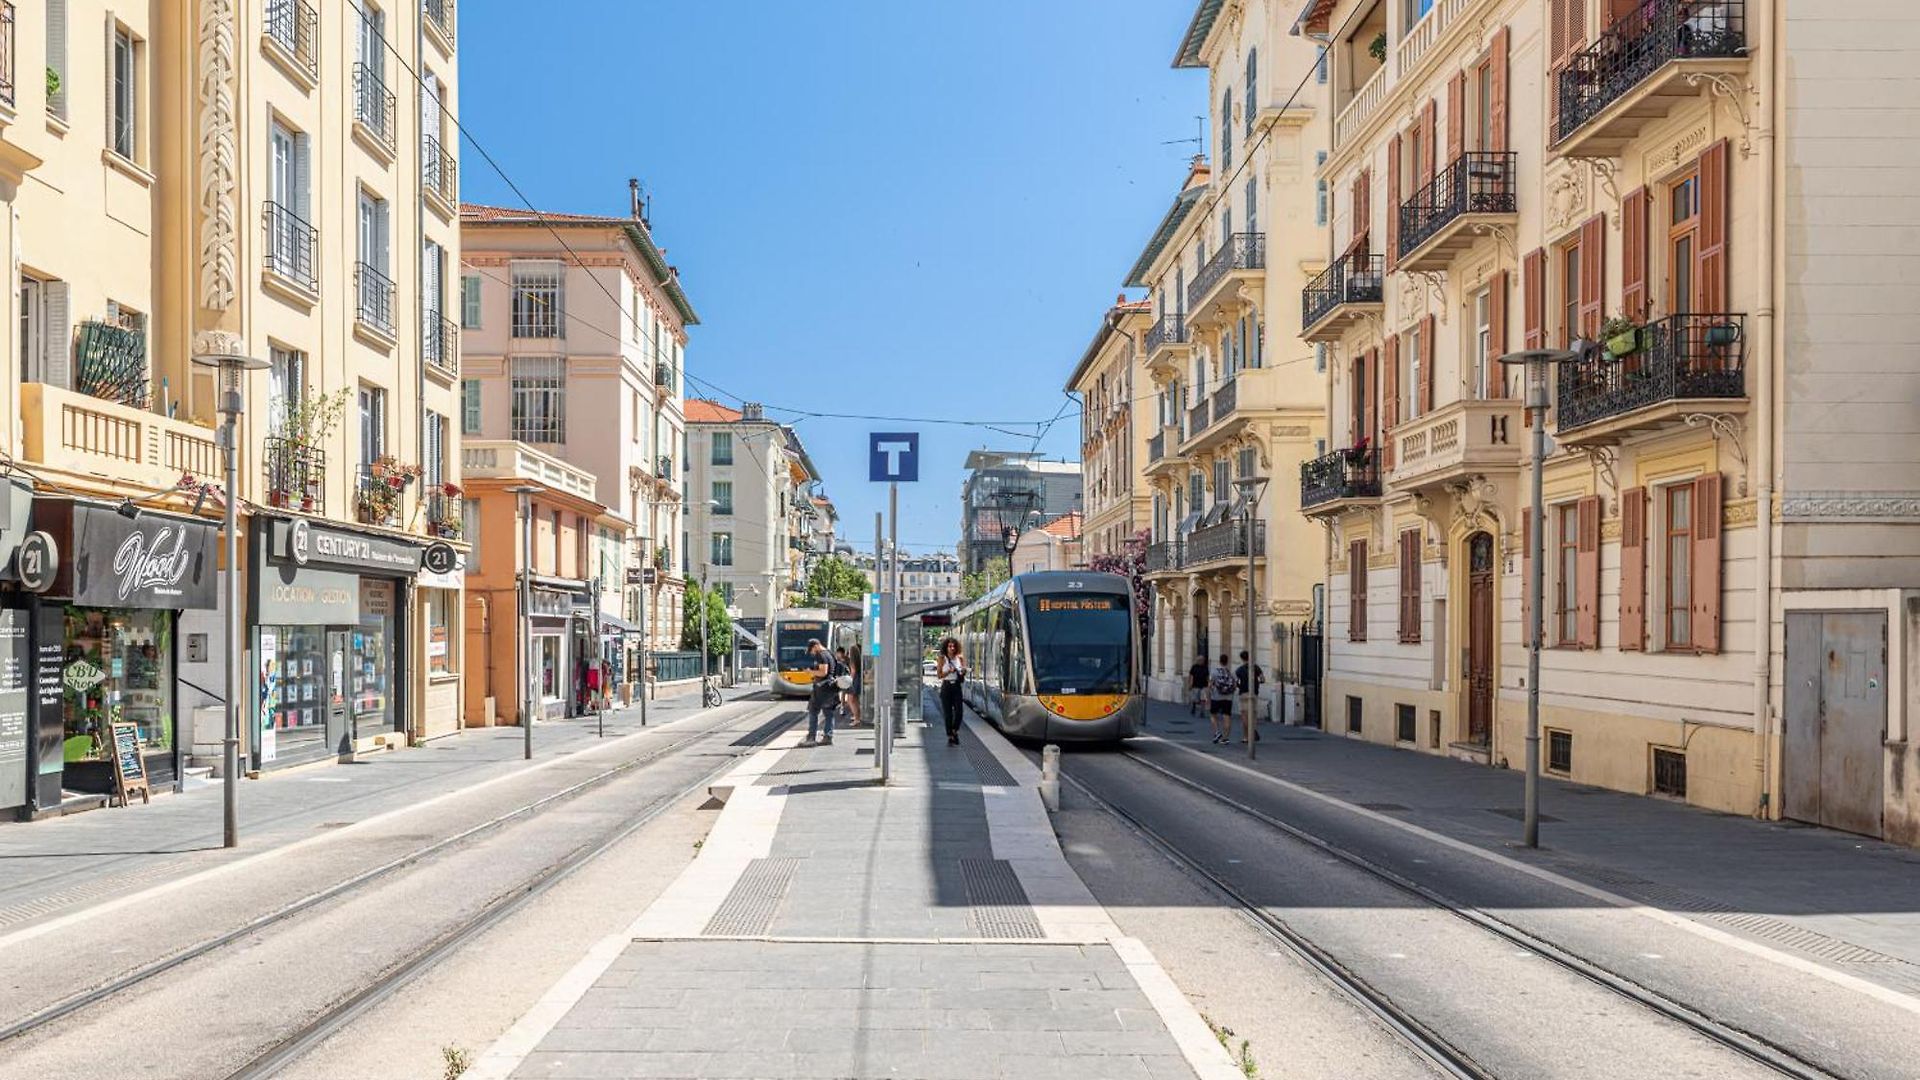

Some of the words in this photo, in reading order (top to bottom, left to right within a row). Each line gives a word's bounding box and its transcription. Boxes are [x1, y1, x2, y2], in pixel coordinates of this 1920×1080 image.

[877, 441, 910, 476] T
[316, 534, 360, 558] CENTURY
[361, 542, 370, 560] 21
[25, 550, 42, 574] 21
[114, 524, 189, 600] Wood
[432, 552, 448, 566] 21
[271, 584, 314, 603] LOCATION
[1067, 581, 1083, 589] 23
[65, 664, 98, 678] CBD
[66, 677, 96, 689] Shop
